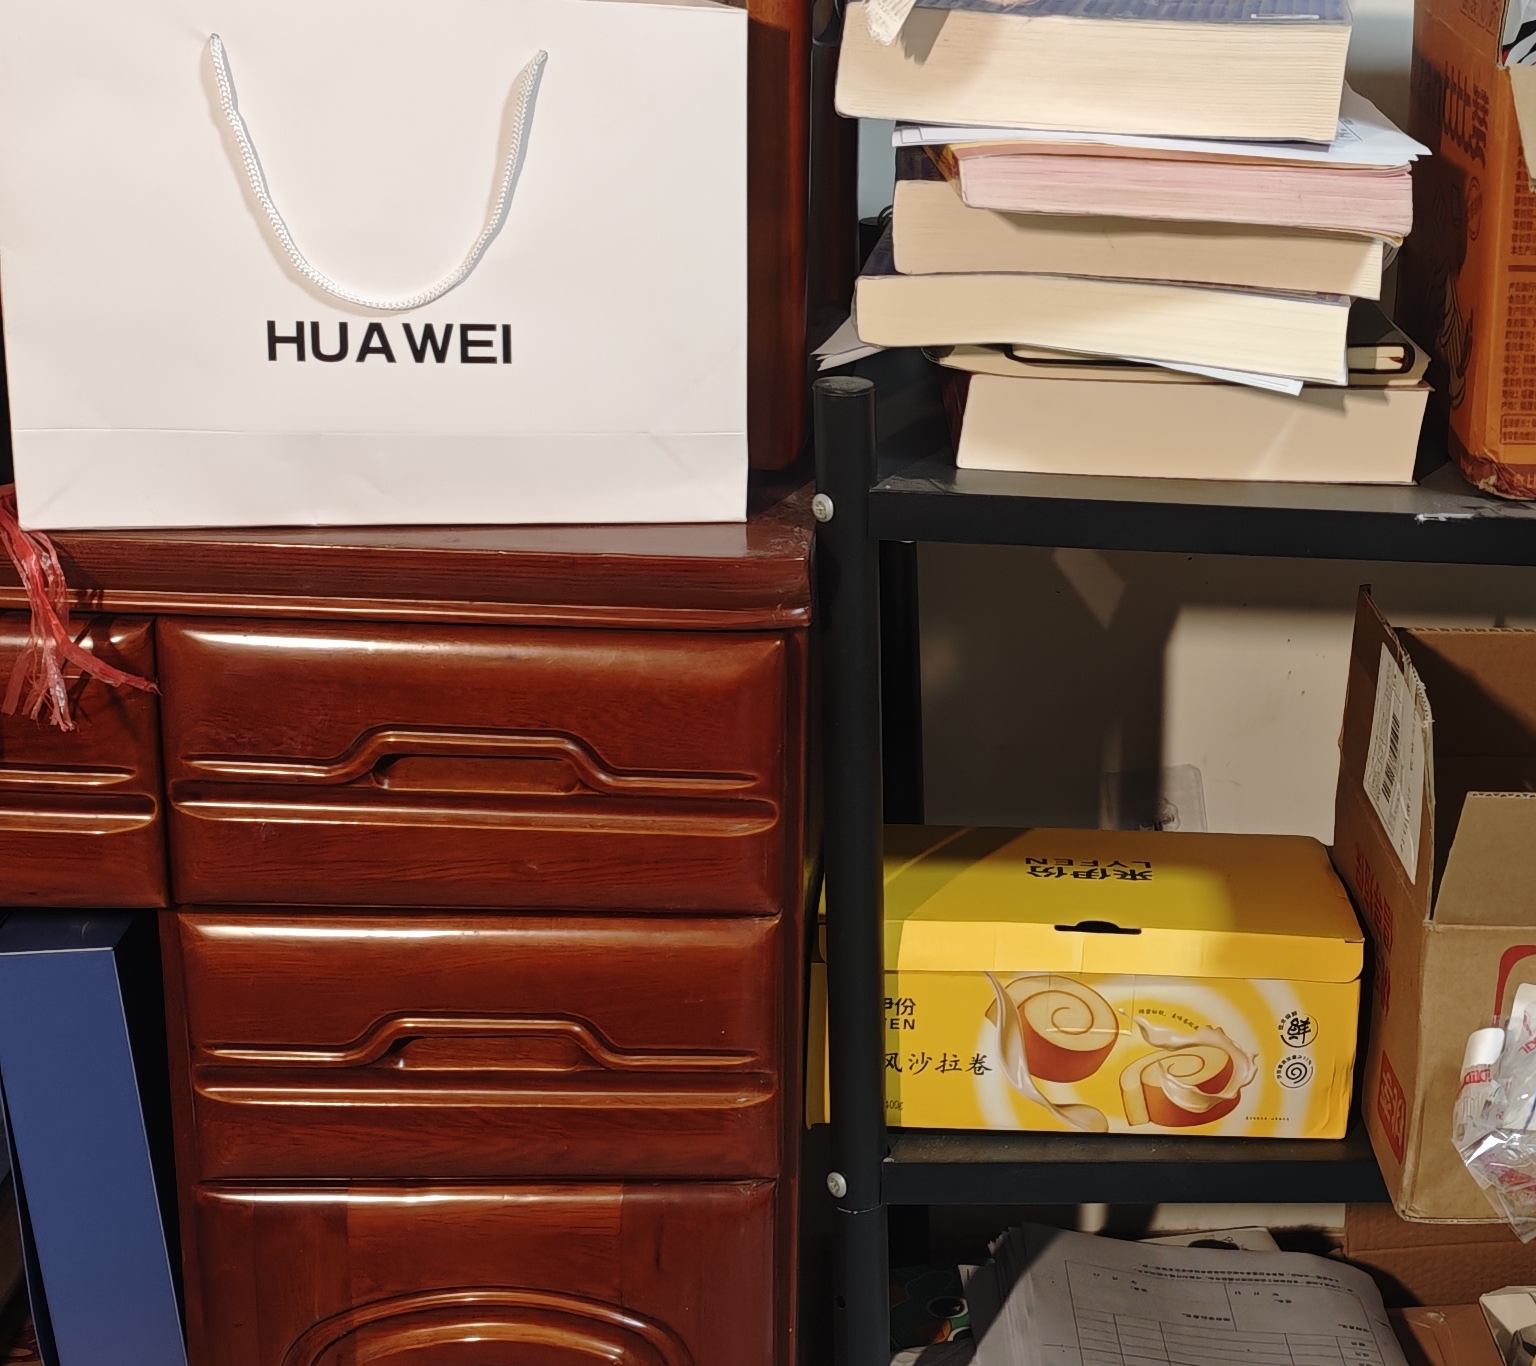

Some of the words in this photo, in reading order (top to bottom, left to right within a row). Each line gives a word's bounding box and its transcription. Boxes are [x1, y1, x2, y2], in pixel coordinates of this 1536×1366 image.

[266, 319, 514, 366] HUAWEI
[1025, 856, 1153, 868] LYFEN
[1026, 866, 1154, 882] 来伊份
[885, 1018, 916, 1031] EN
